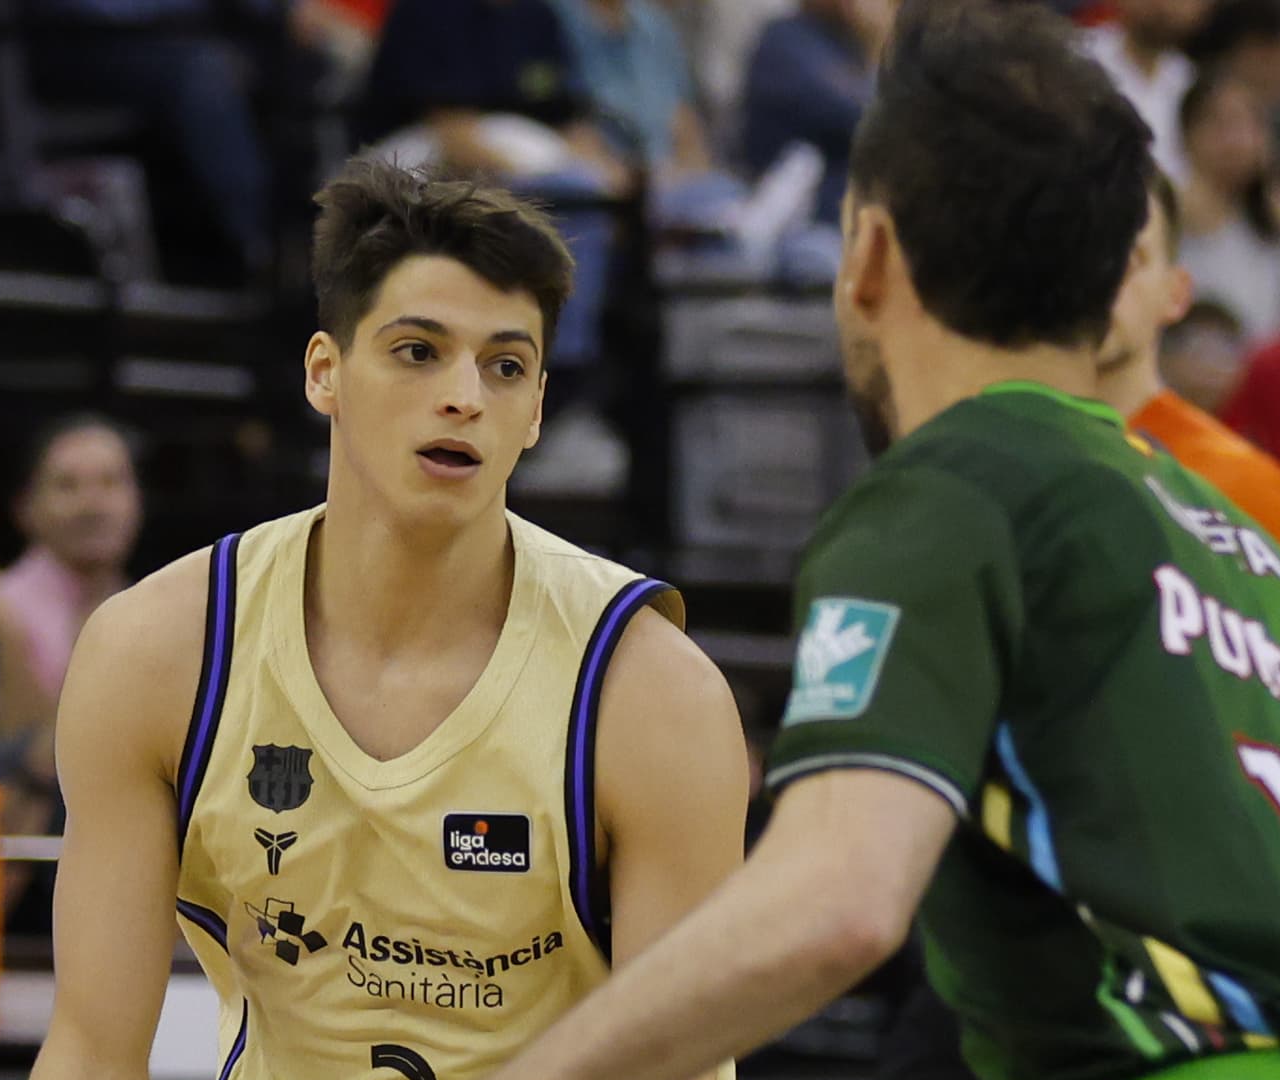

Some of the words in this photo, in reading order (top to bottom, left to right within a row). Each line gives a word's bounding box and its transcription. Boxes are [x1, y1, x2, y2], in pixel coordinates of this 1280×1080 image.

[450, 831, 484, 850] liga
[451, 848, 525, 866] endesa
[342, 921, 564, 977] Assistència
[347, 955, 504, 1009] Sanitària
